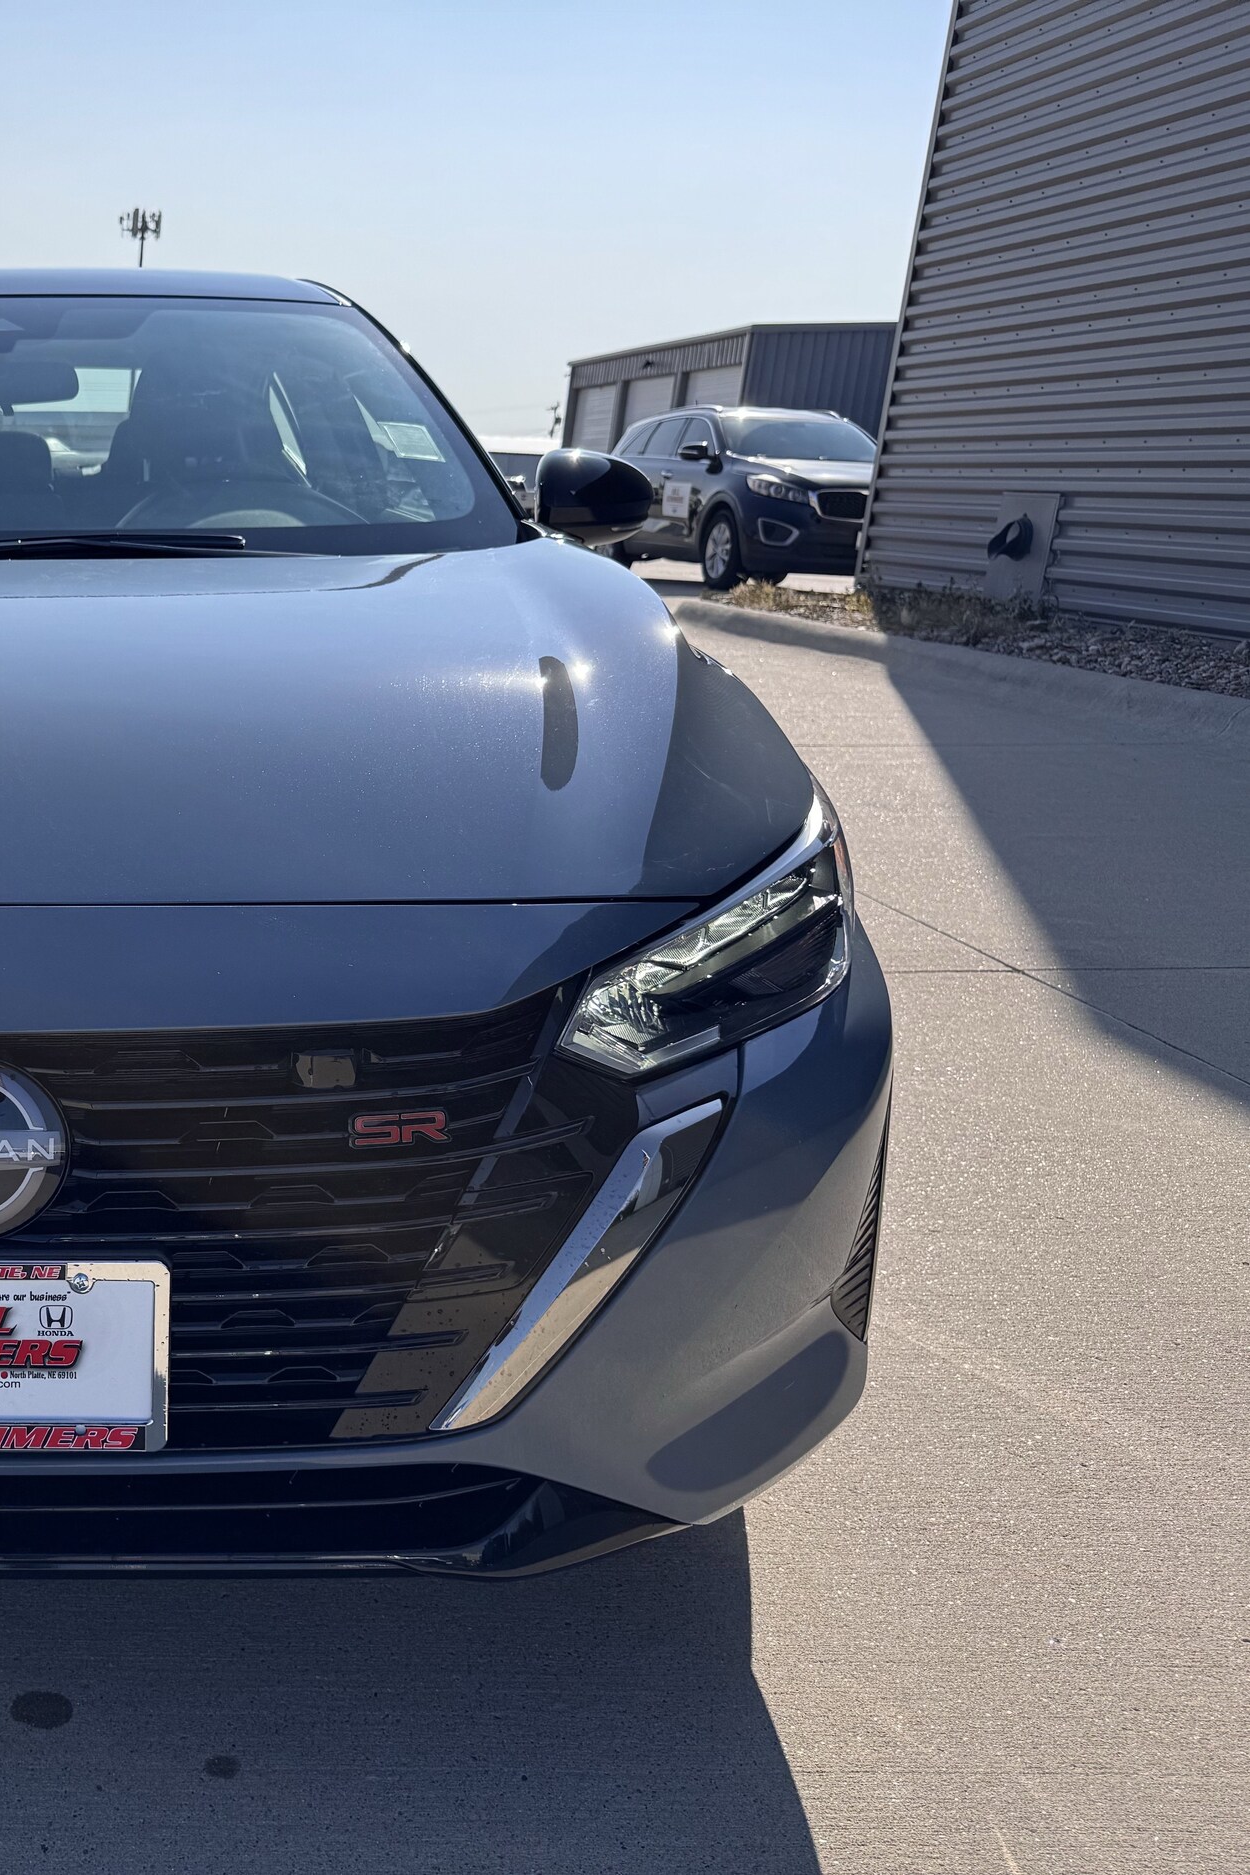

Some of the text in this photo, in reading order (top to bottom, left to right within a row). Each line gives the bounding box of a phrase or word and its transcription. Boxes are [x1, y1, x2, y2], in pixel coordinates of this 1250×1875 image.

[354, 1111, 448, 1146] SR
[30, 1265, 62, 1279] NE
[9, 1370, 26, 1379] North
[27, 1370, 47, 1380] Platte,
[47, 1371, 57, 1379] NE
[57, 1371, 77, 1379] 69101
